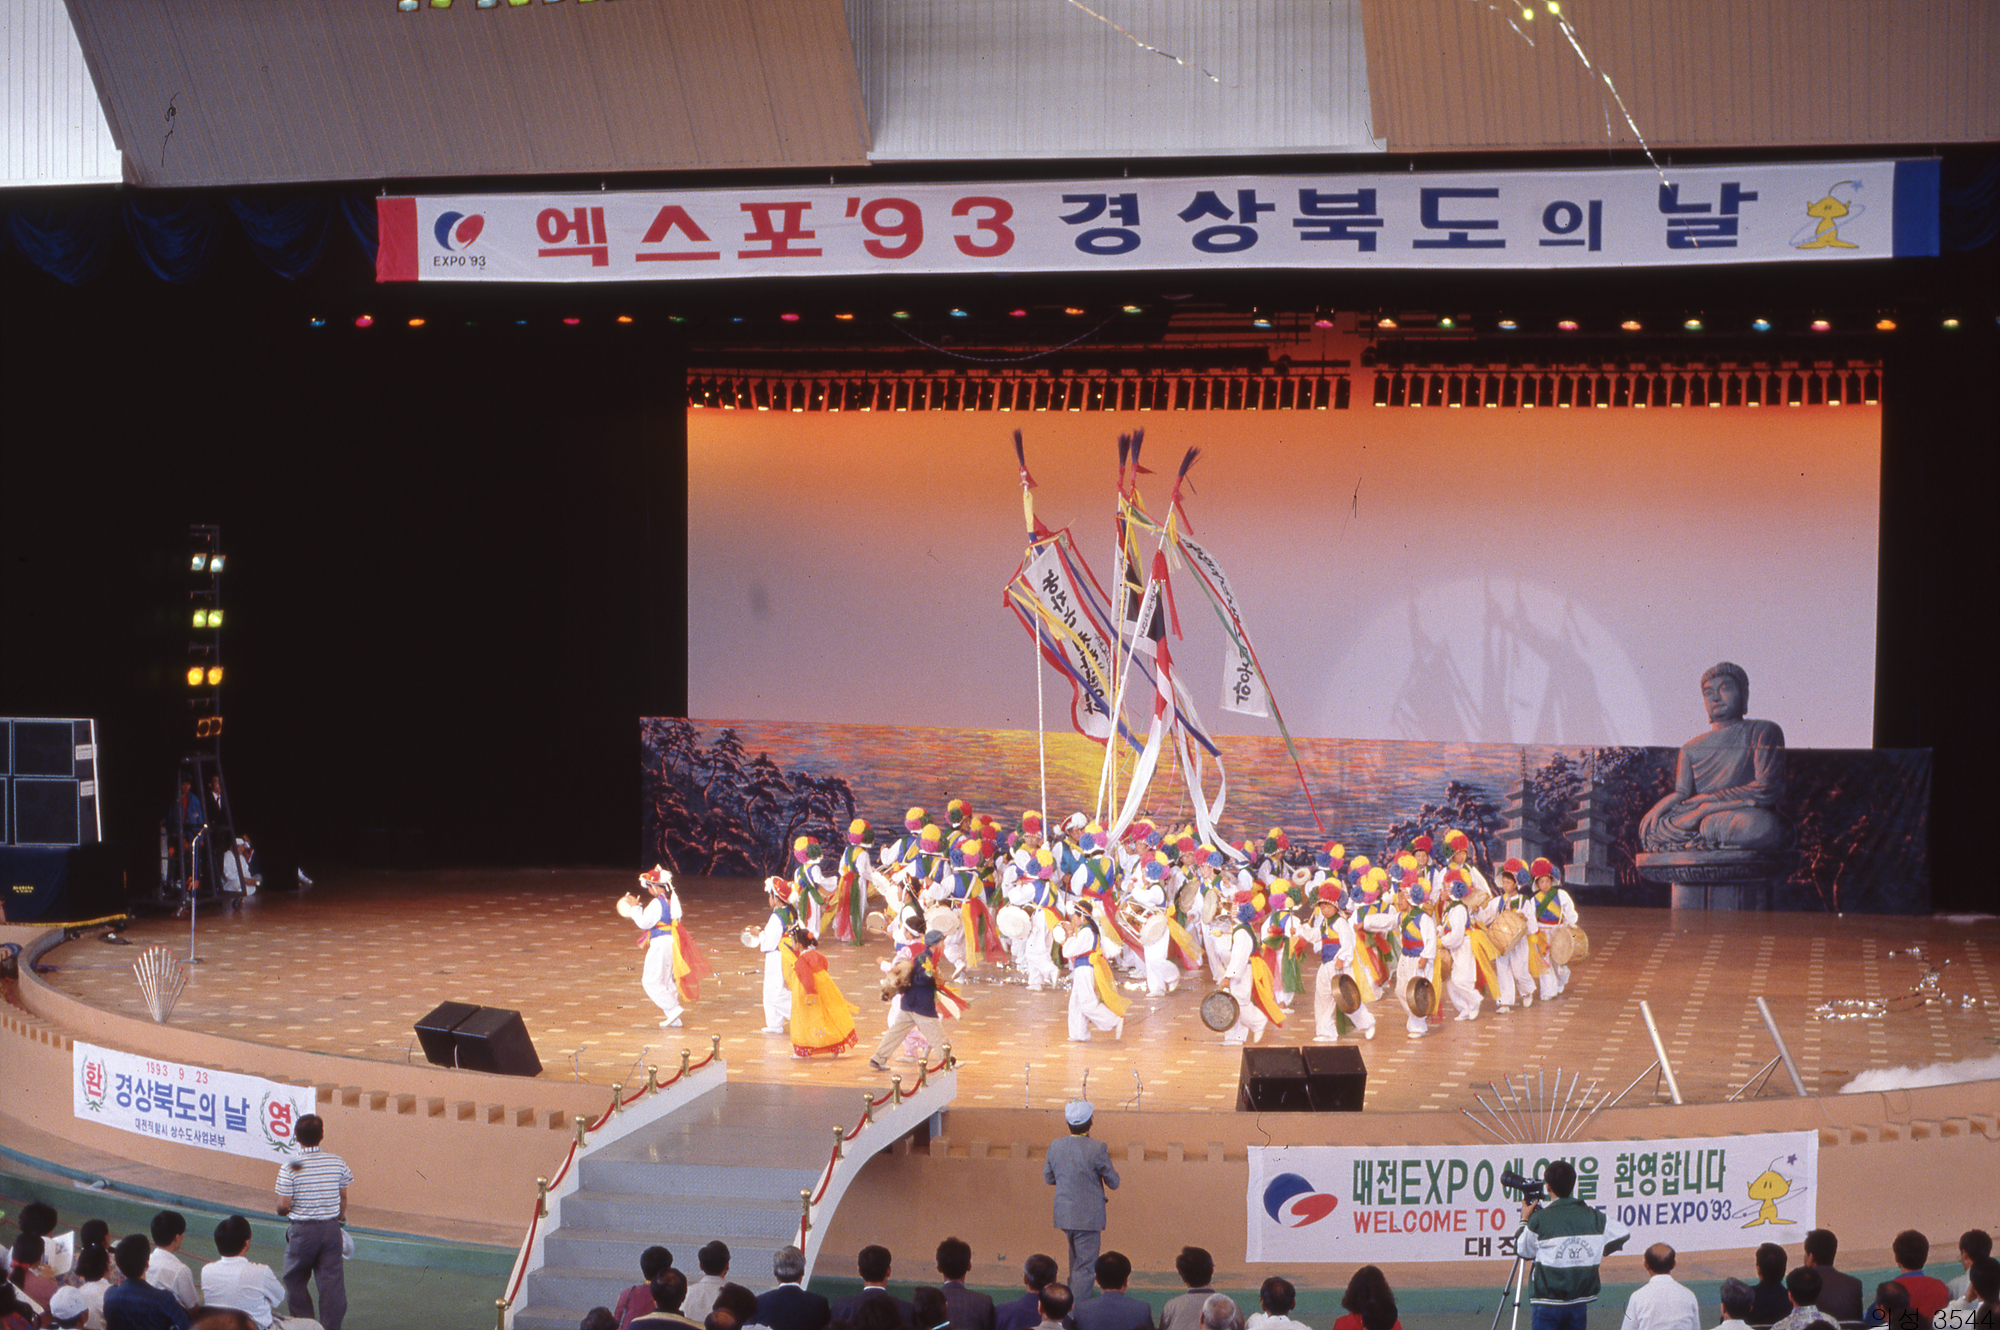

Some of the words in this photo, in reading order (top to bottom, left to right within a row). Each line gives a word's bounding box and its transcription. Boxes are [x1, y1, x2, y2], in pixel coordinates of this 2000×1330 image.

[1060, 187, 1602, 256] 경상북도의
[1658, 181, 1759, 250] 날
[433, 256, 466, 267] EXPO
[86, 1061, 102, 1098] 환
[146, 1062, 169, 1078] 1993
[178, 1067, 185, 1081] 9
[195, 1070, 209, 1085] 23
[115, 1073, 216, 1127] 경상북도의
[224, 1095, 250, 1133] 날
[269, 1101, 292, 1138] 영
[1614, 1149, 1726, 1198] 환영합니다
[1353, 1210, 1468, 1234] WELCOME
[1475, 1208, 1506, 1231] TO
